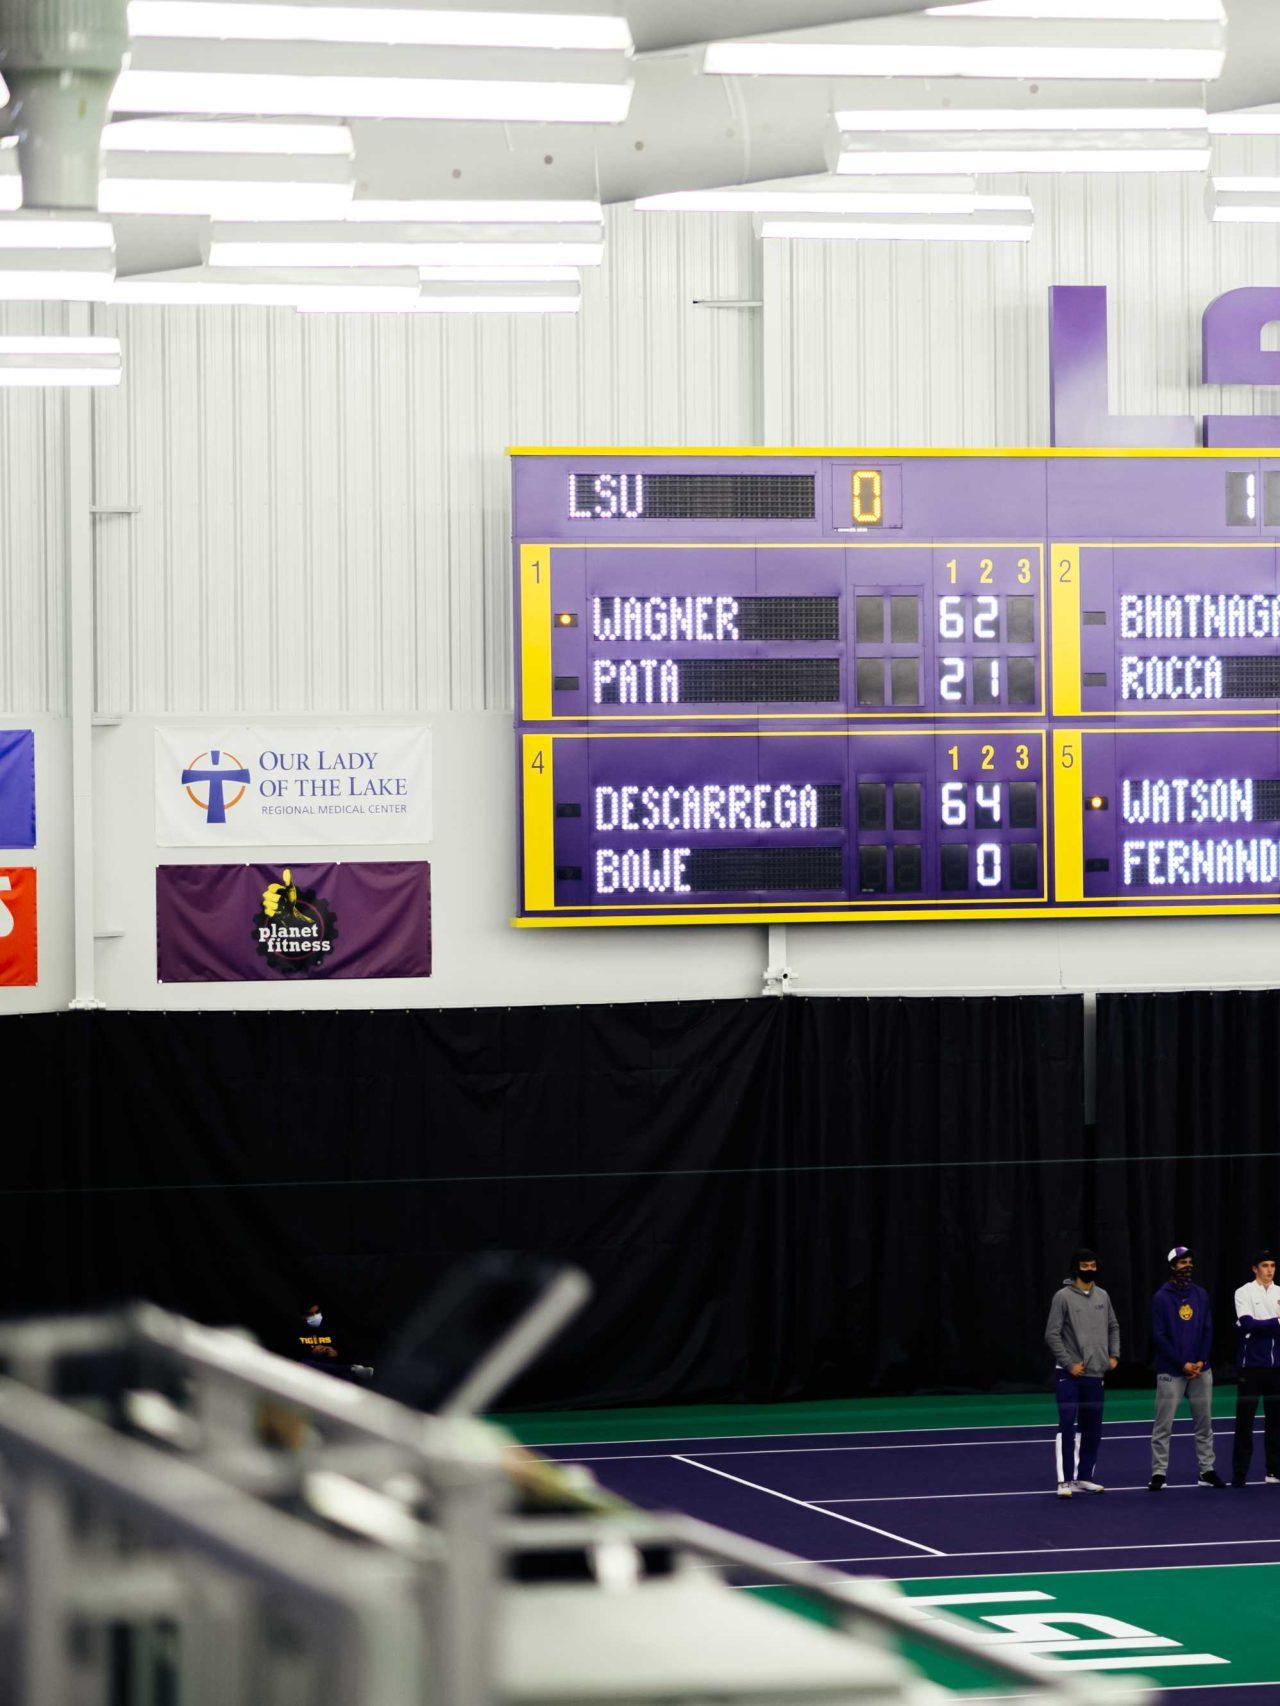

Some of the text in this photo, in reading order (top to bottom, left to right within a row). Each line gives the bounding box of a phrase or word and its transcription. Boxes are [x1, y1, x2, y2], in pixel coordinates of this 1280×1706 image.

[569, 474, 643, 518] LSU
[531, 560, 541, 584] 1
[946, 559, 1031, 584] 1 2 3
[1059, 559, 1072, 584] 2
[594, 597, 739, 641] WAGNER
[594, 659, 678, 703] PATA
[1121, 655, 1222, 699] ROCCA
[259, 751, 378, 771] OUR LADY
[531, 750, 544, 775] 4
[949, 745, 1029, 770] 1 2 3
[1061, 745, 1074, 768] 5
[259, 777, 408, 797] OF THE LAKE
[261, 804, 407, 815] REGIONAL MEDICAL CENTER
[596, 784, 817, 830] DESCARREGA
[1123, 778, 1252, 824] WATSON
[596, 848, 691, 893] BOWE
[977, 844, 1001, 886] 0
[258, 924, 318, 942] planet
[267, 938, 331, 952] fitness
